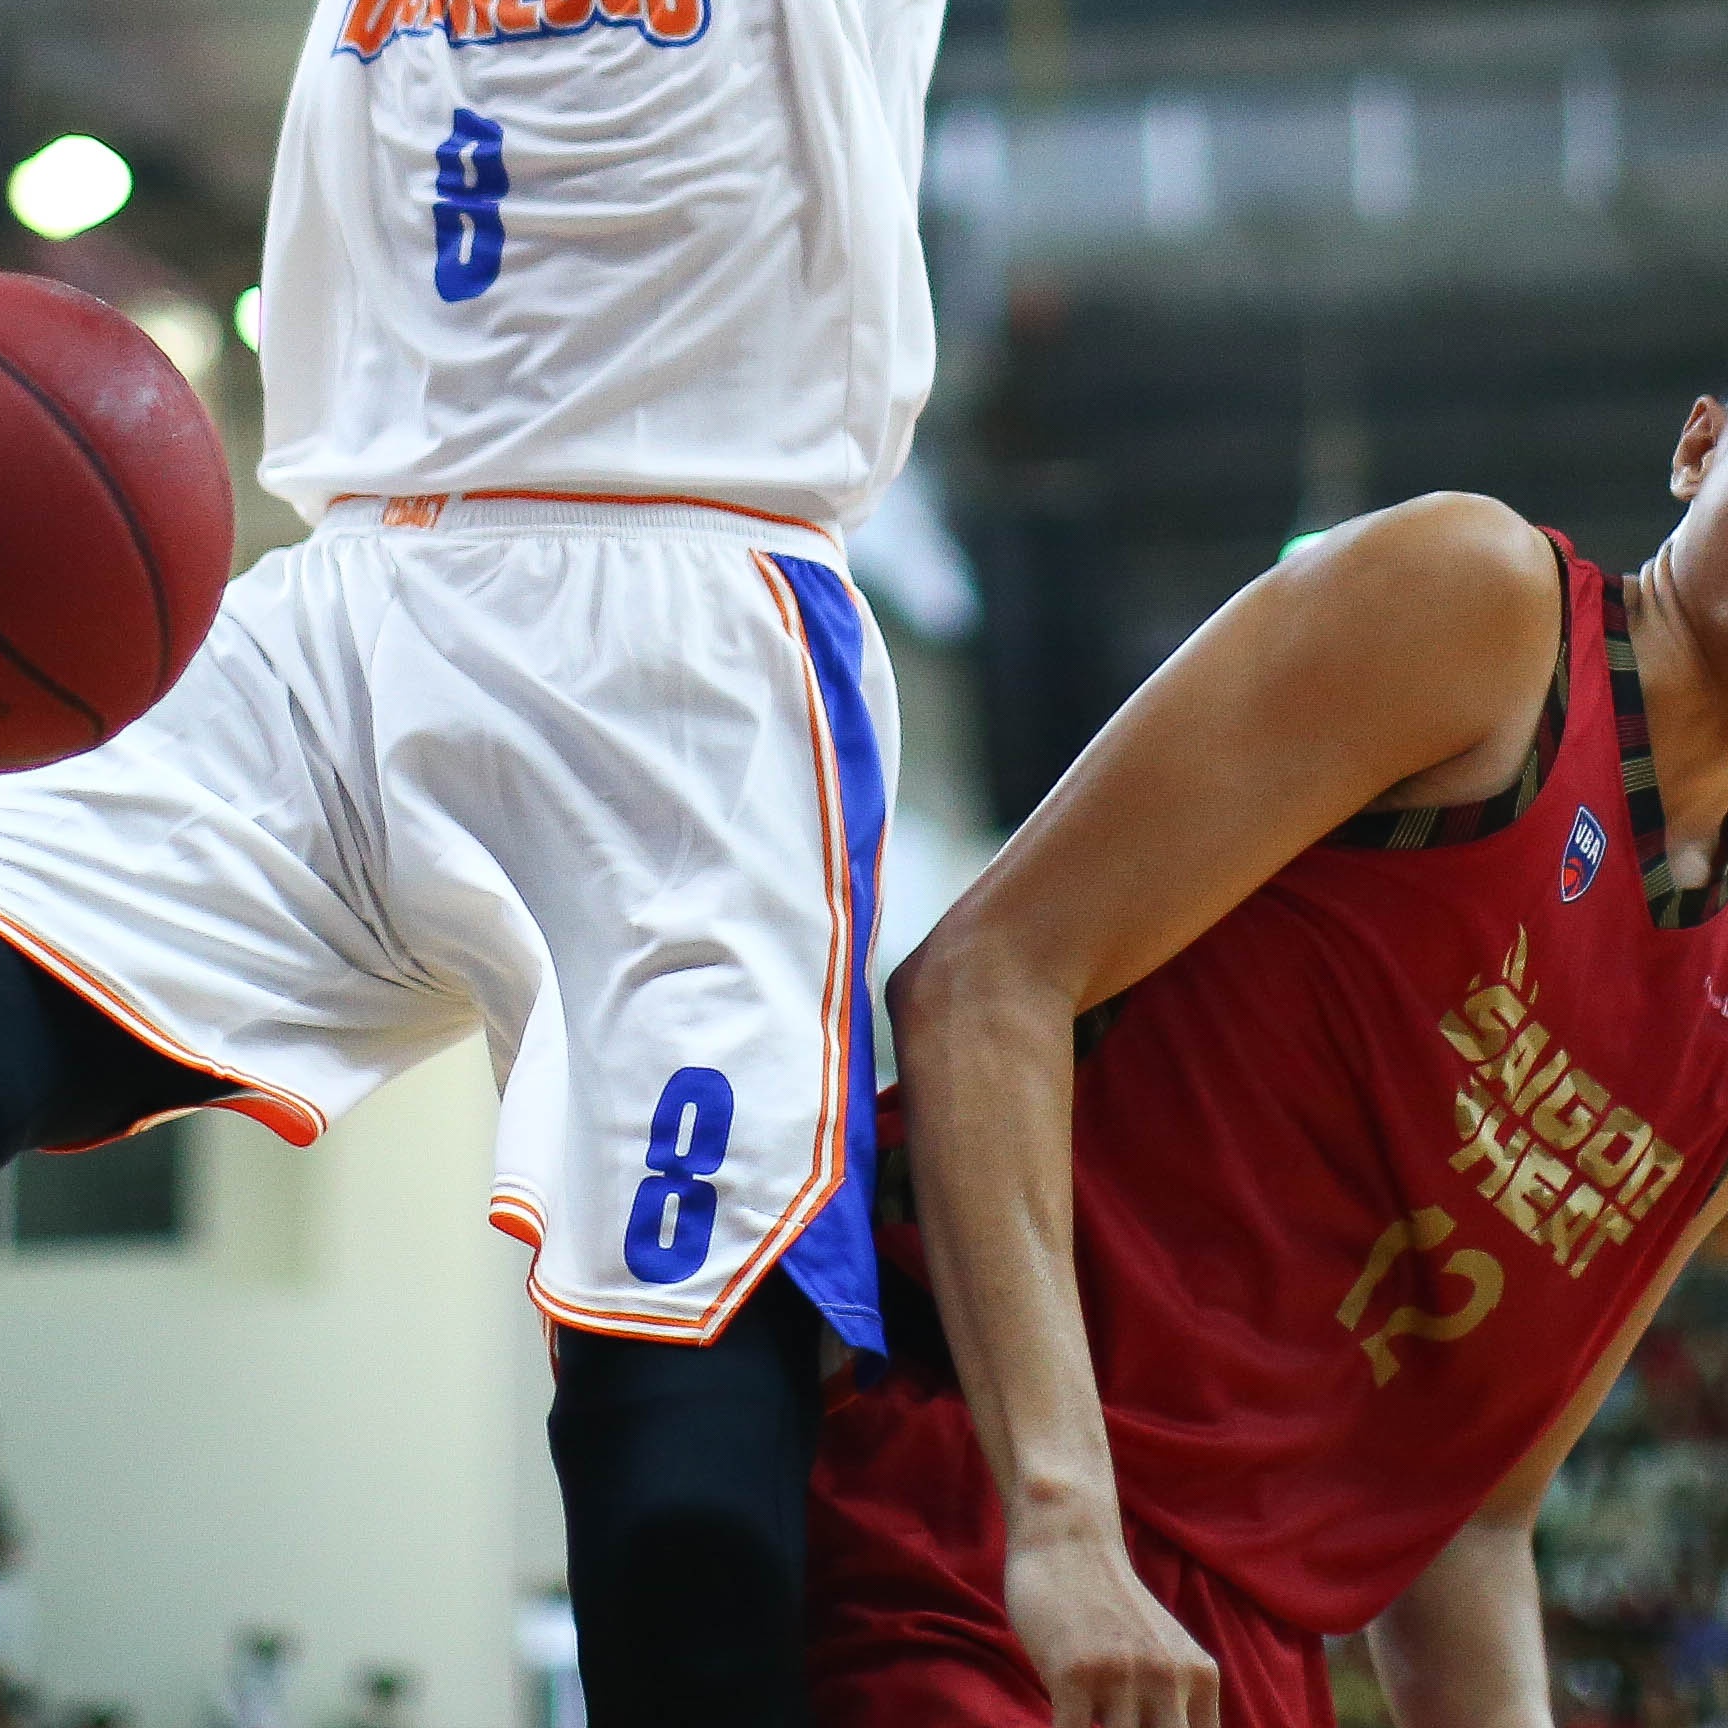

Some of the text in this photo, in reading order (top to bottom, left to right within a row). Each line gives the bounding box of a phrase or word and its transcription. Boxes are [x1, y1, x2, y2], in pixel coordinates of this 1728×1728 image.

[433, 108, 509, 303] 8
[1575, 824, 1600, 864] VBA
[624, 1066, 734, 1284] 8
[1438, 983, 1685, 1220] SAIGON
[1448, 1107, 1635, 1279] HEAT
[1335, 1204, 1506, 1389] 12
